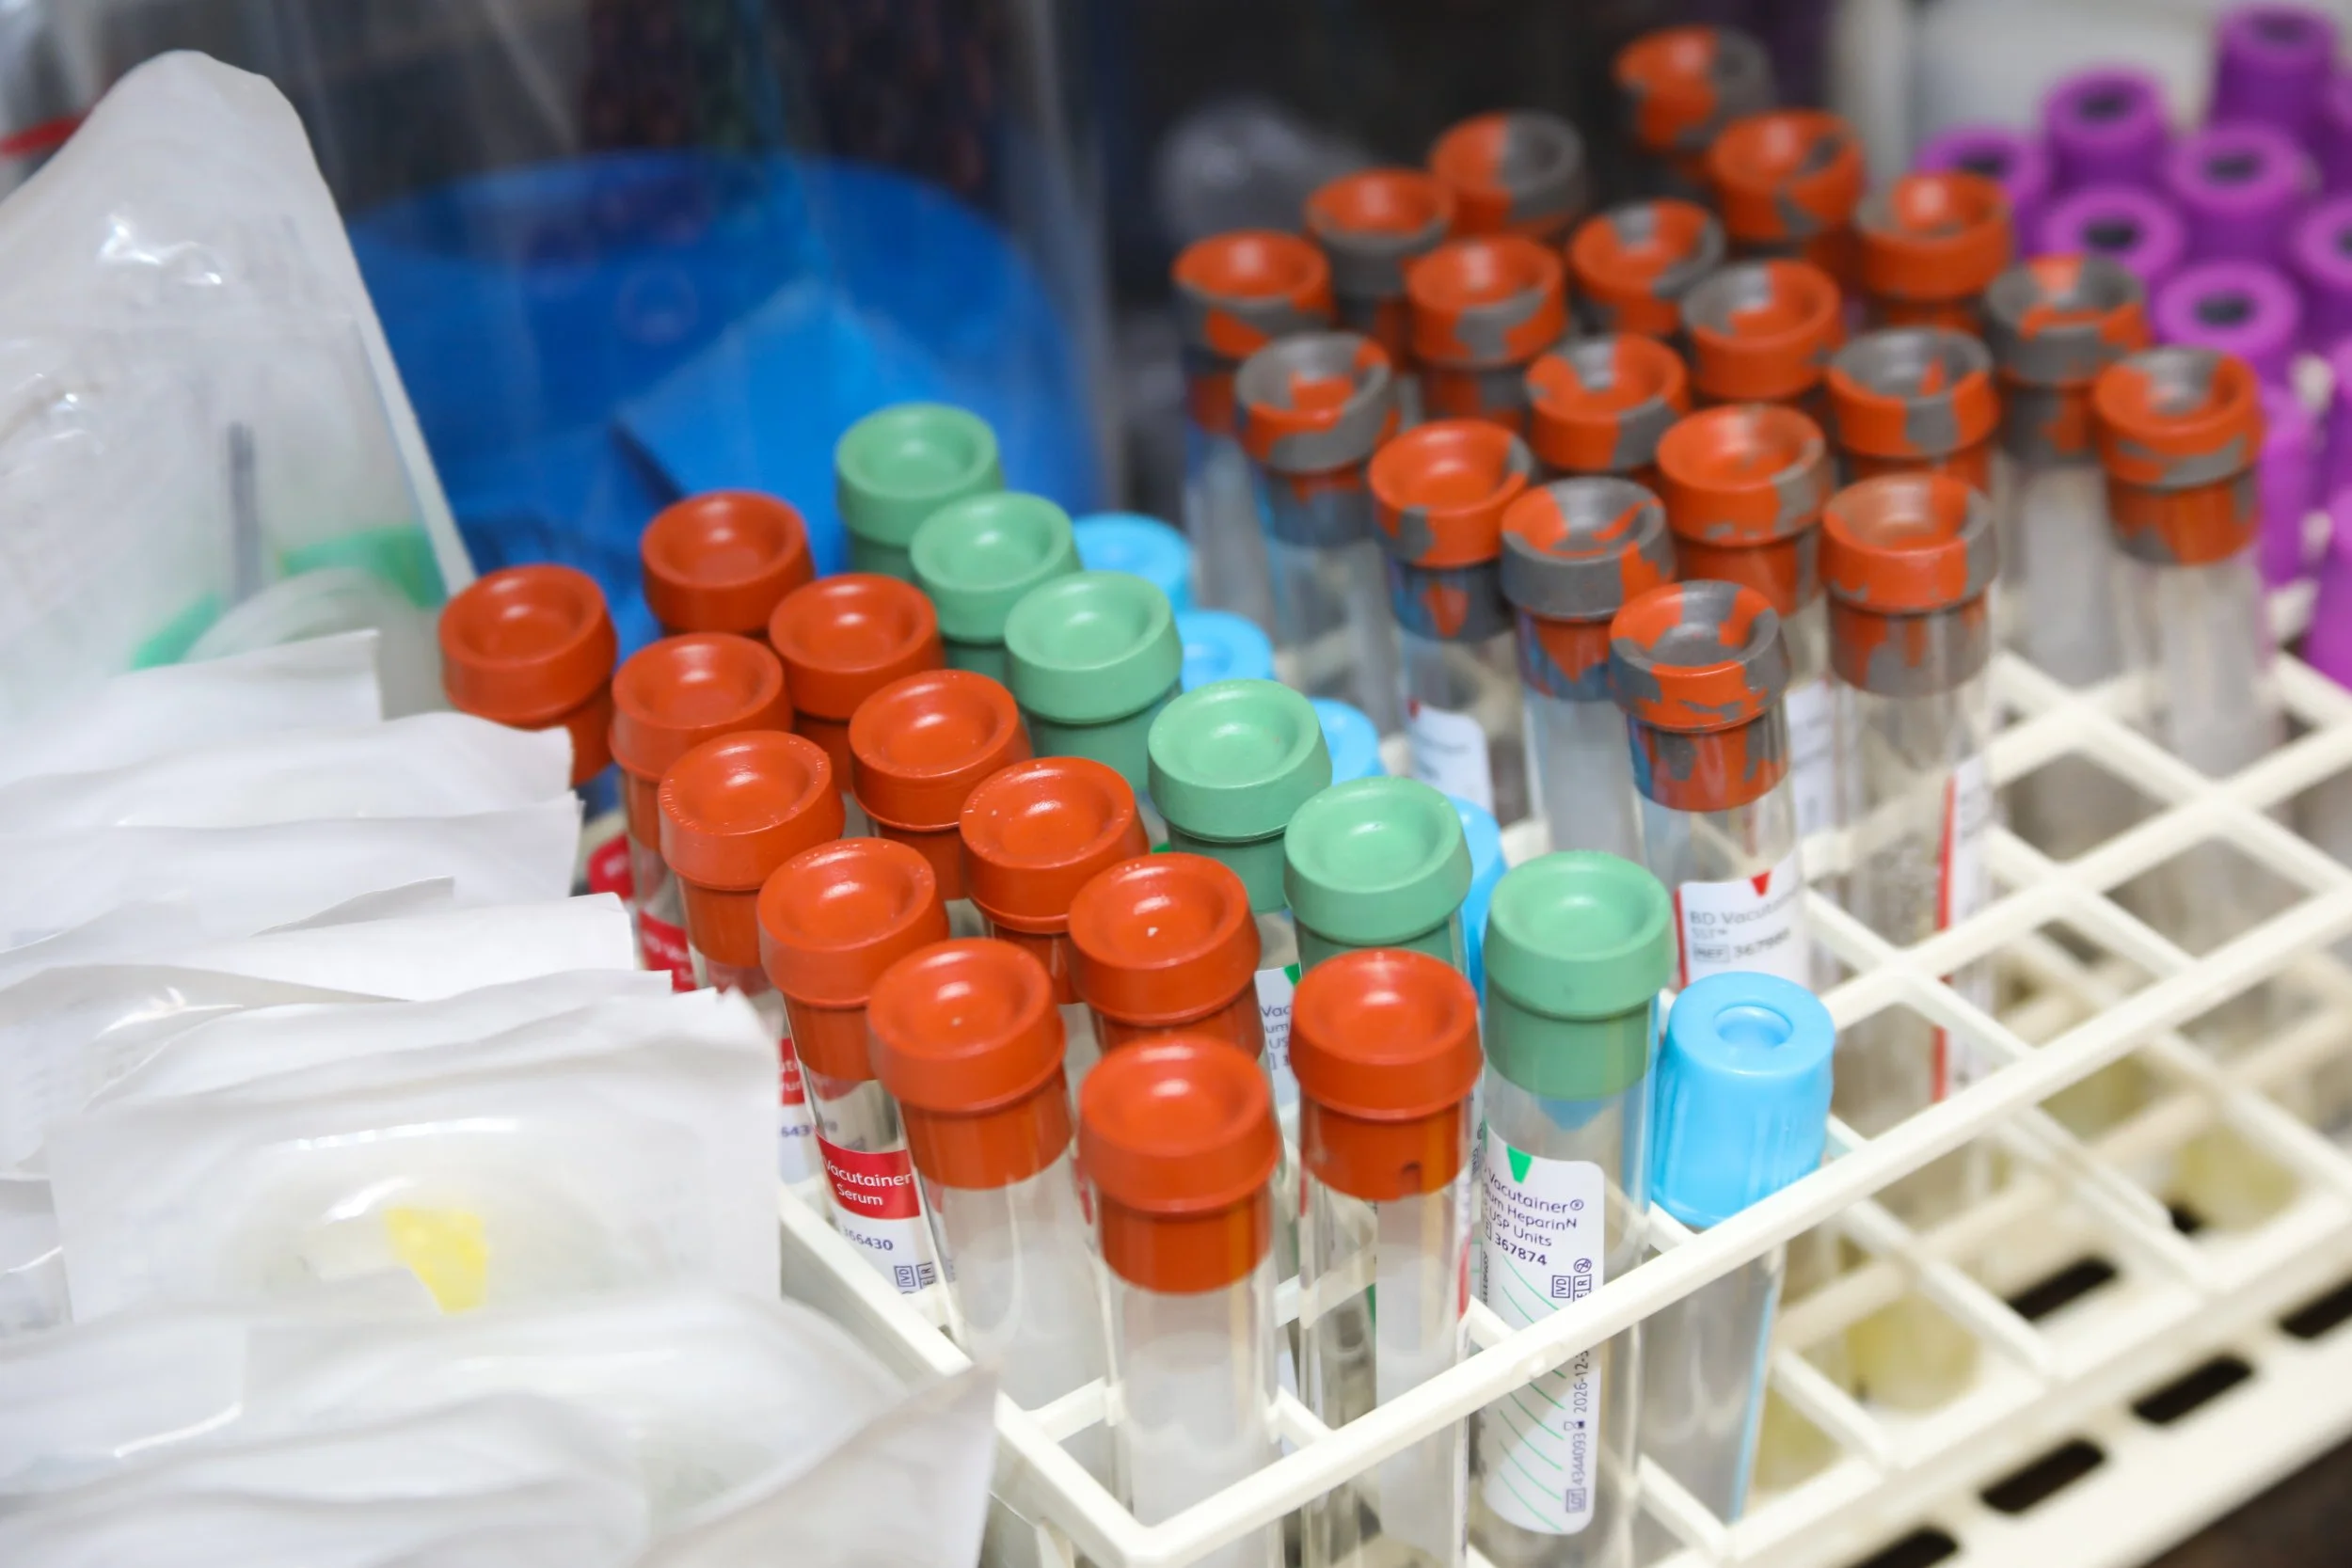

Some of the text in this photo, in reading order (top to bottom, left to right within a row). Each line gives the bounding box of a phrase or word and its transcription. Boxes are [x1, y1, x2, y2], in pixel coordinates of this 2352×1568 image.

[1690, 911, 1715, 926] BD
[824, 1159, 912, 1187] Vacutainer
[836, 1183, 883, 1206] Serum
[1489, 1206, 1510, 1229] USP
[1513, 1225, 1552, 1247] Units
[1494, 1232, 1548, 1266] 367874
[1555, 1278, 1567, 1295] IVD
[1572, 1433, 1586, 1486] 4344093
